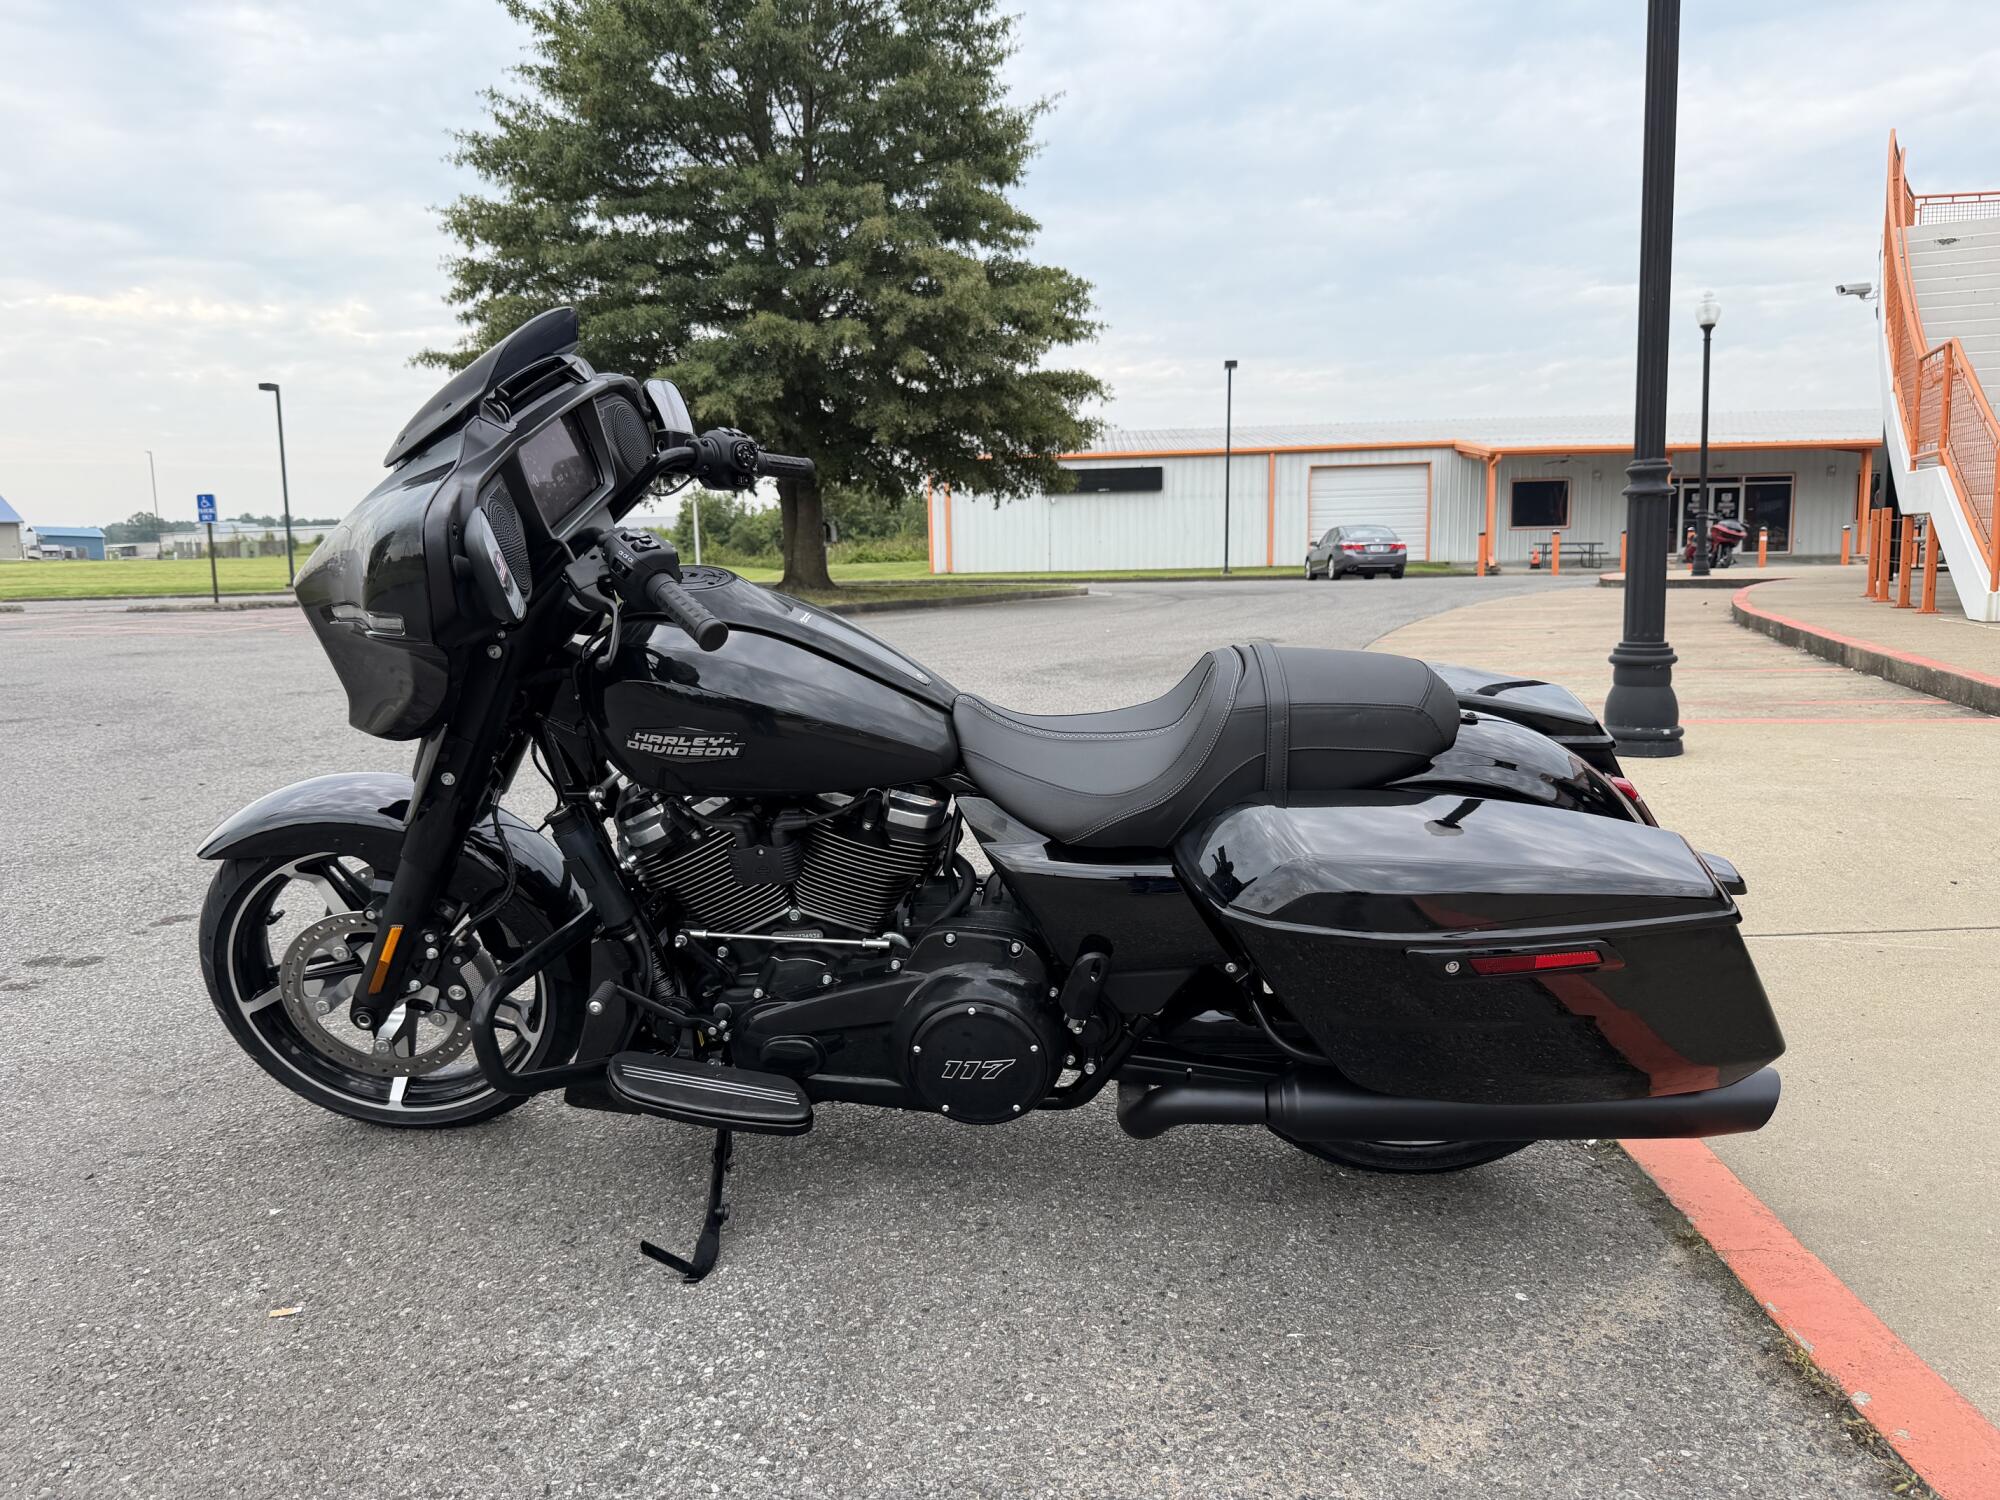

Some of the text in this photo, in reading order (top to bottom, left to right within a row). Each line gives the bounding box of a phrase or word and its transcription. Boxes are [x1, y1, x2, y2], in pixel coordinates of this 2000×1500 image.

[626, 739, 739, 756] DAVIDSON
[634, 732, 732, 746] HARLEY-
[941, 1059, 1017, 1080] 117
